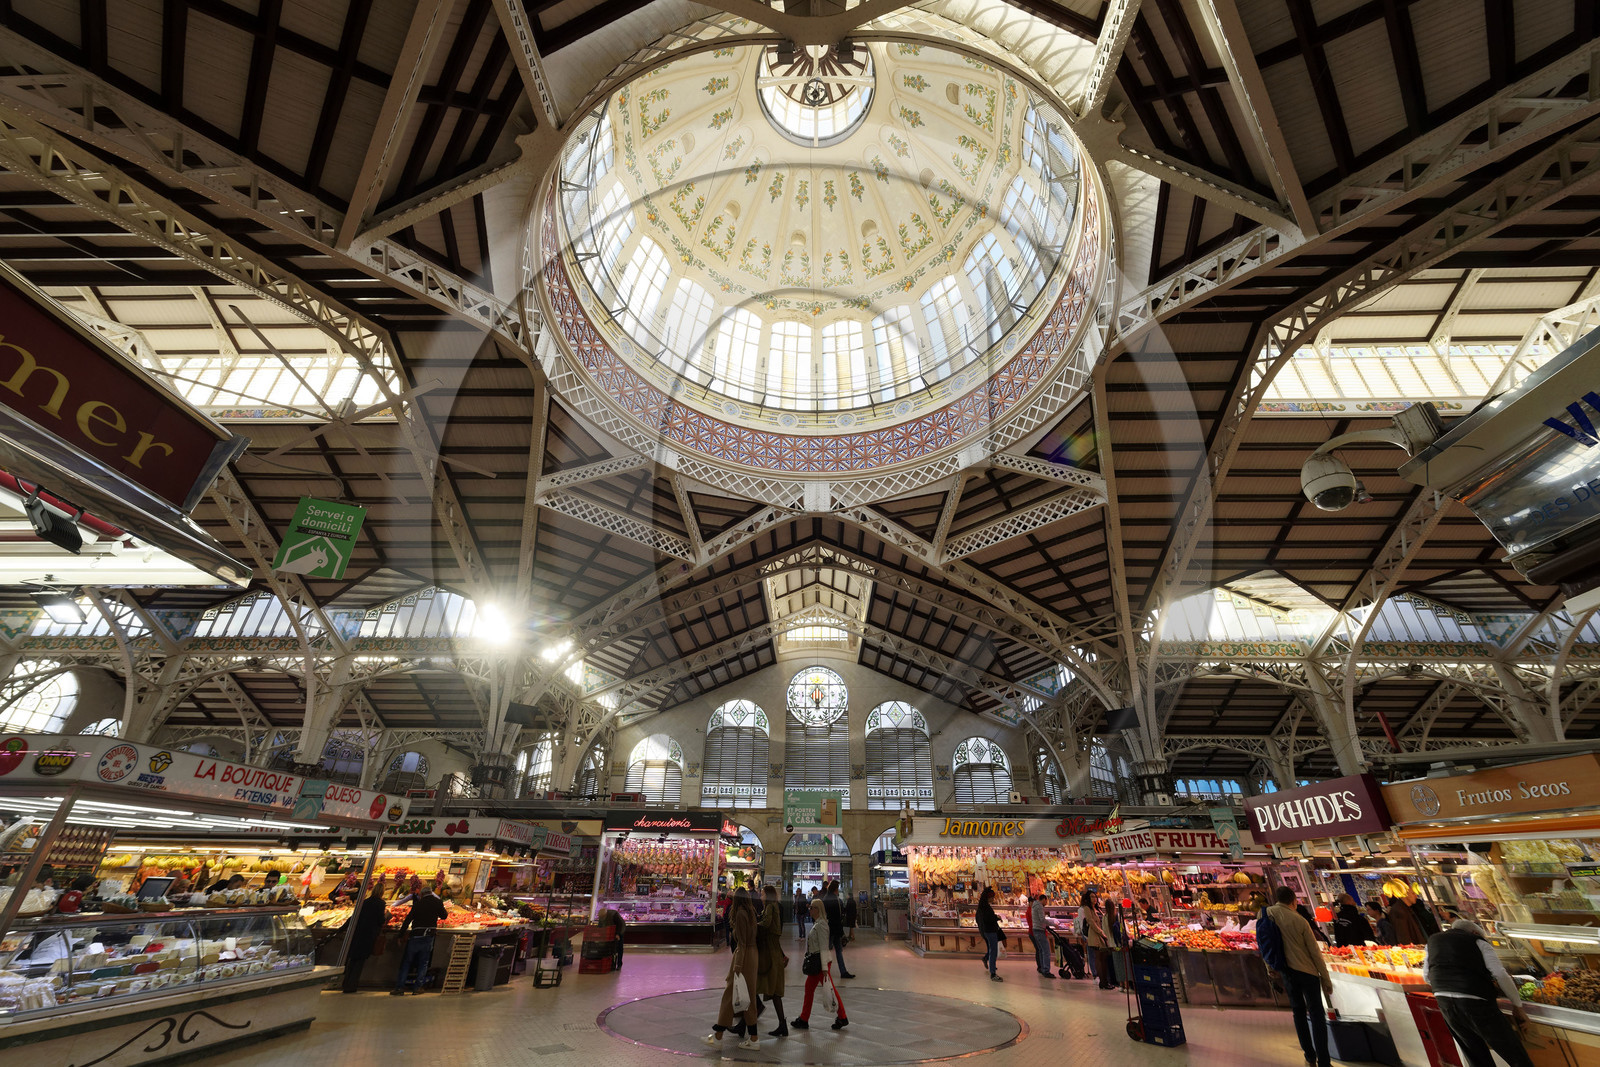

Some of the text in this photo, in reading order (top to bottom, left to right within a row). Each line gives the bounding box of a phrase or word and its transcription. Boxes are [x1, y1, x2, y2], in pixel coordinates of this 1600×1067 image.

[306, 505, 345, 520] Servei
[302, 517, 351, 533] domicili
[308, 529, 327, 537] ESPANYA
[38, 755, 71, 766] ONNO
[194, 759, 216, 780] LA
[220, 765, 294, 793] BOUTIQUE
[325, 785, 362, 804] QUESO
[234, 788, 277, 805] EXTENSA
[1456, 780, 1571, 807] Frutos Secos
[787, 816, 816, 824] A CASA
[1253, 790, 1362, 833] PUCHADES
[386, 819, 436, 835] RESAS
[500, 822, 528, 840] VIRGINIA
[939, 817, 1026, 837] Jamones
[545, 832, 571, 849] VIRGIN
[1112, 831, 1153, 851] FRUTAS
